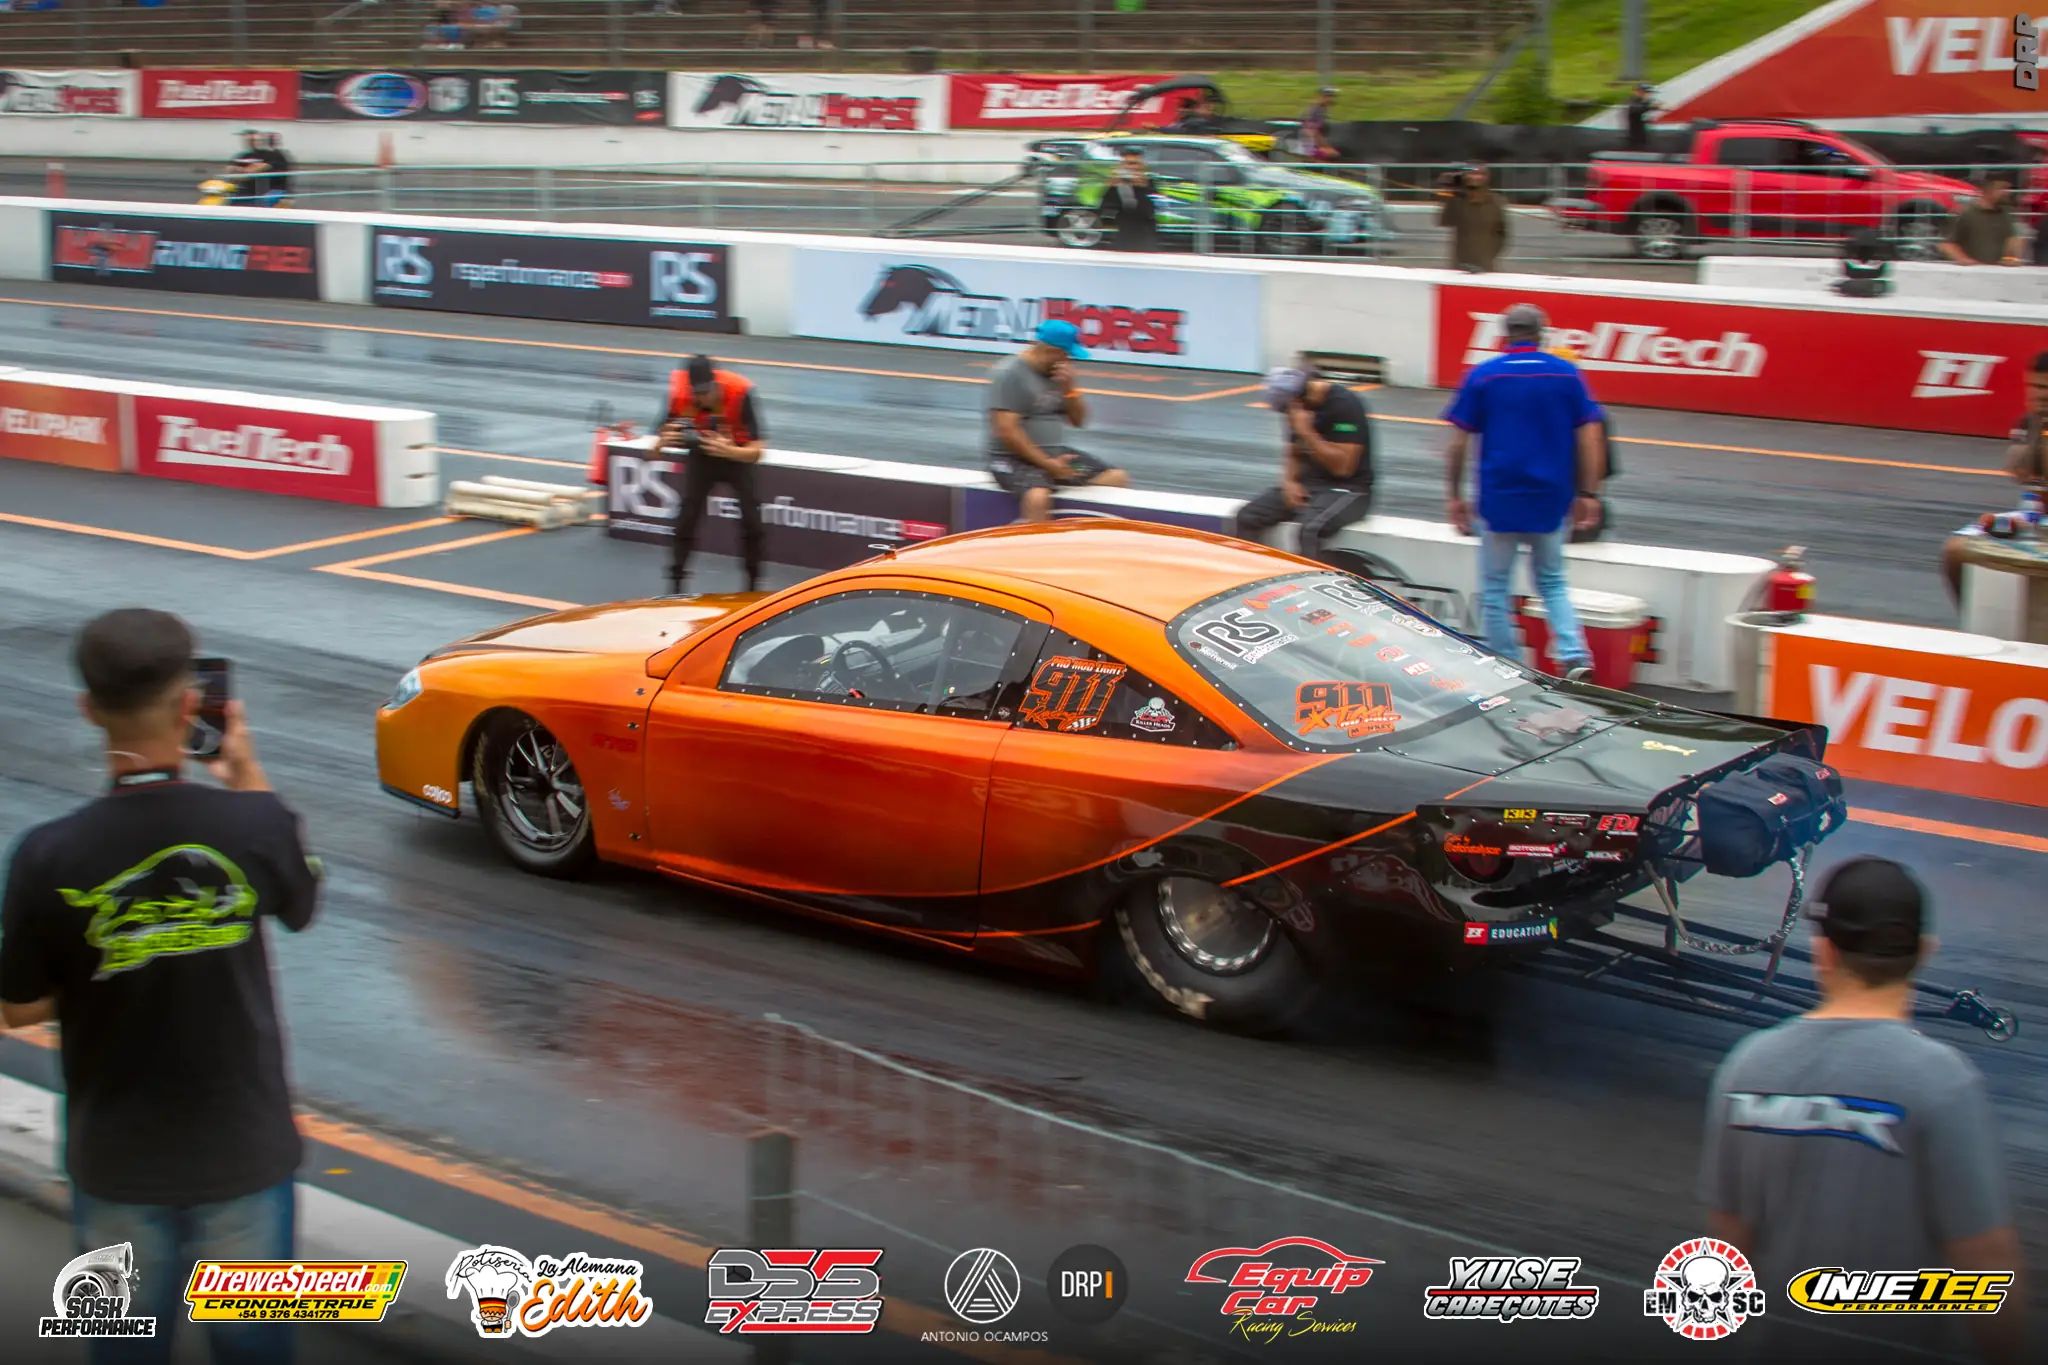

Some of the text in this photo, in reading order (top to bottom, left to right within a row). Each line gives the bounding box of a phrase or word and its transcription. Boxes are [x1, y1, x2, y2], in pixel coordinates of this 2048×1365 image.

[376, 234, 433, 285] RS
[650, 250, 718, 305] RS
[609, 455, 682, 521] RS
[1192, 607, 1283, 658] RS
[1050, 658, 1070, 669] PRO
[1807, 663, 2048, 770] VELO
[1490, 924, 1548, 939] EDUCATION
